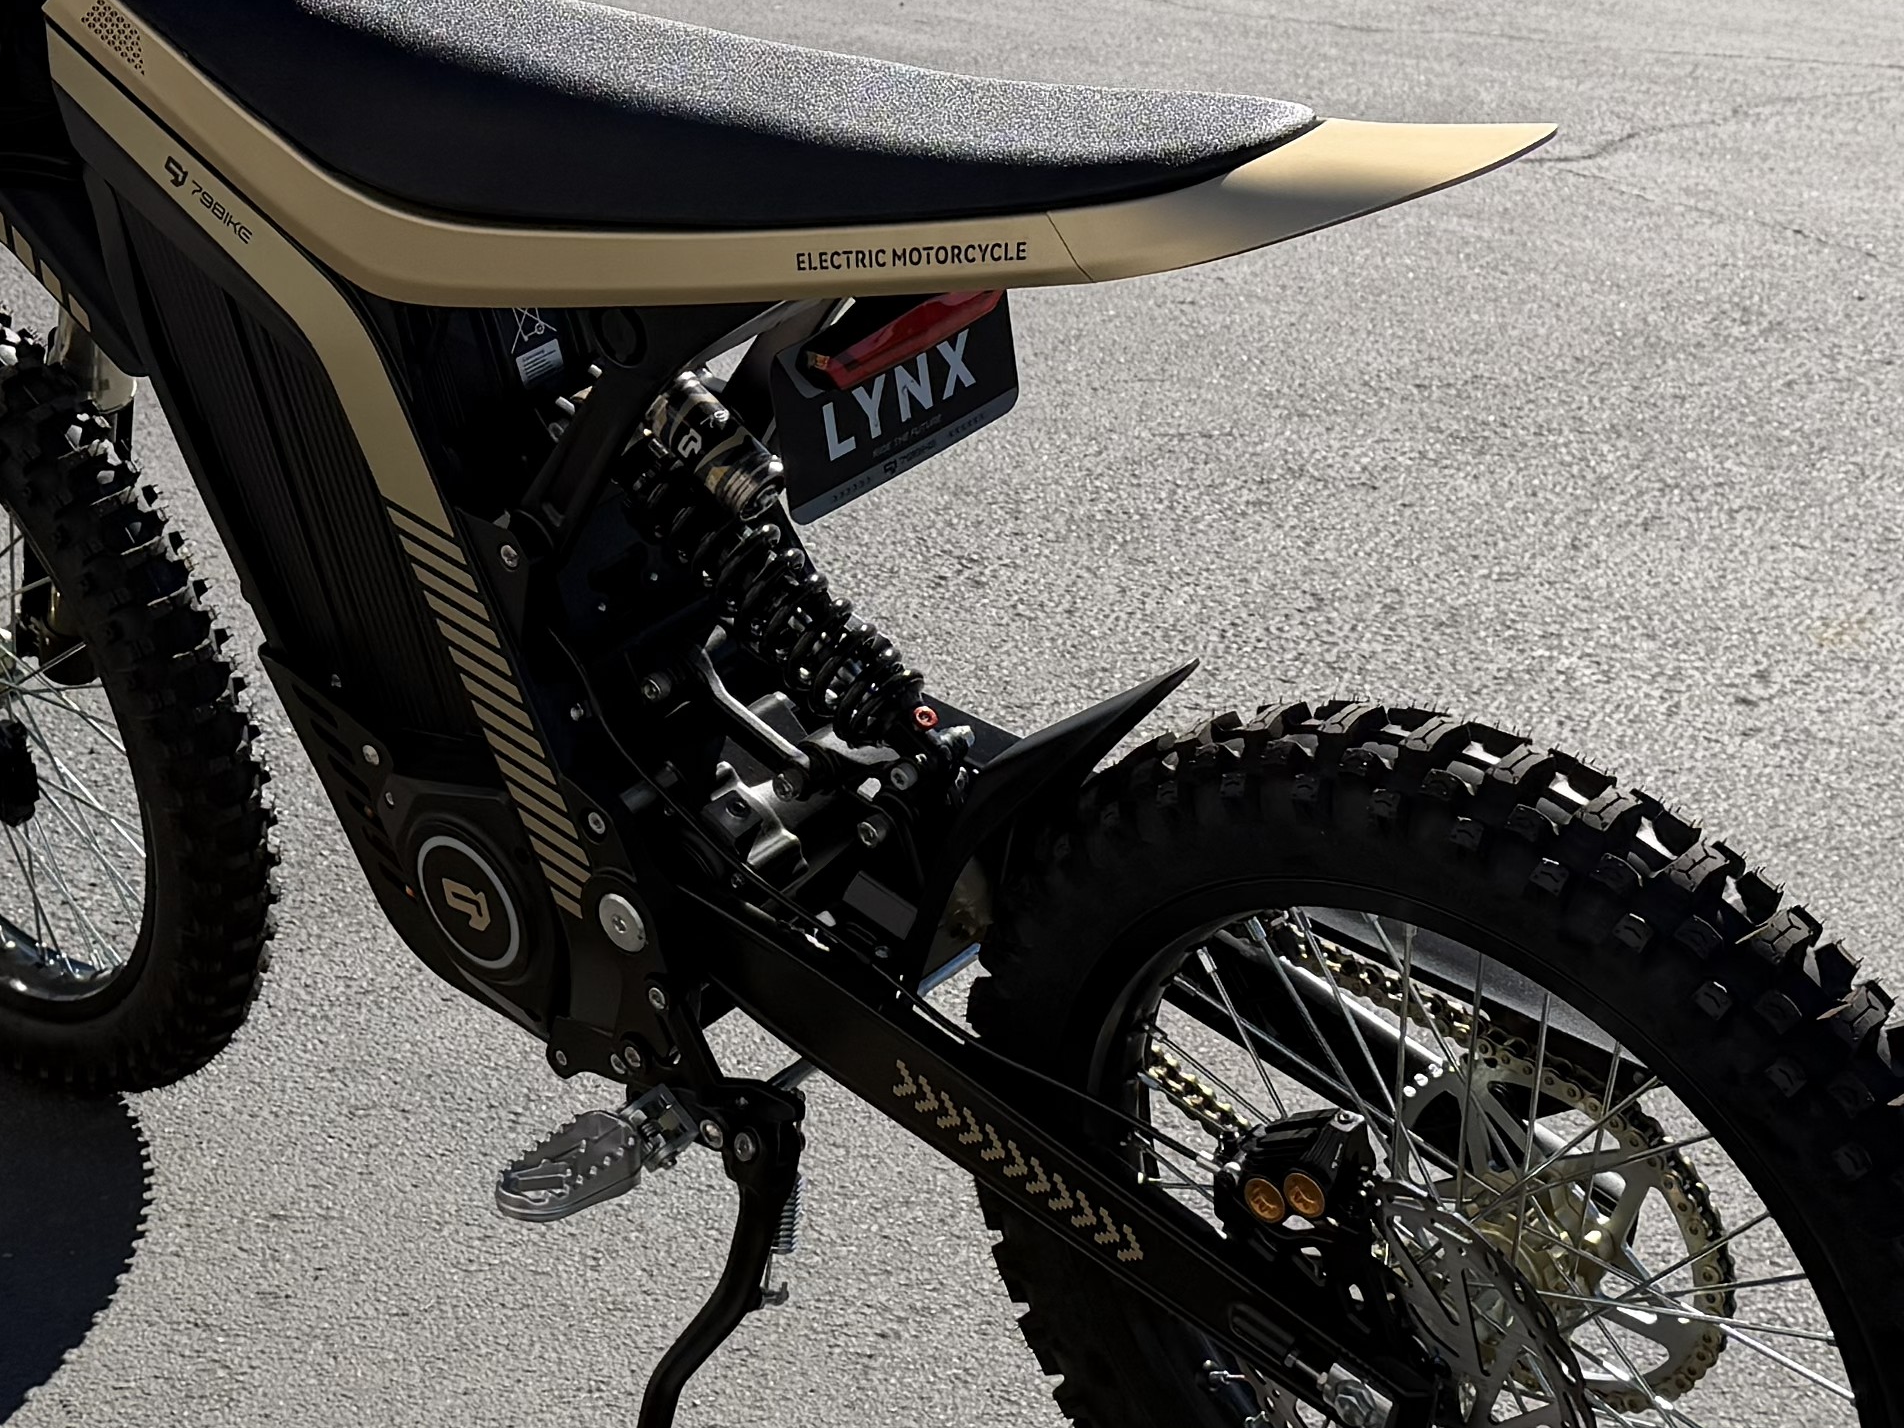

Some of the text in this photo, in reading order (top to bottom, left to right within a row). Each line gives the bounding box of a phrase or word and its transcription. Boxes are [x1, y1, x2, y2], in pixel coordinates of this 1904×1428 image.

[191, 179, 253, 245] 79BIKE
[796, 241, 1028, 271] ELECTRIC MOTORCYCLE
[821, 328, 978, 462] LYNX
